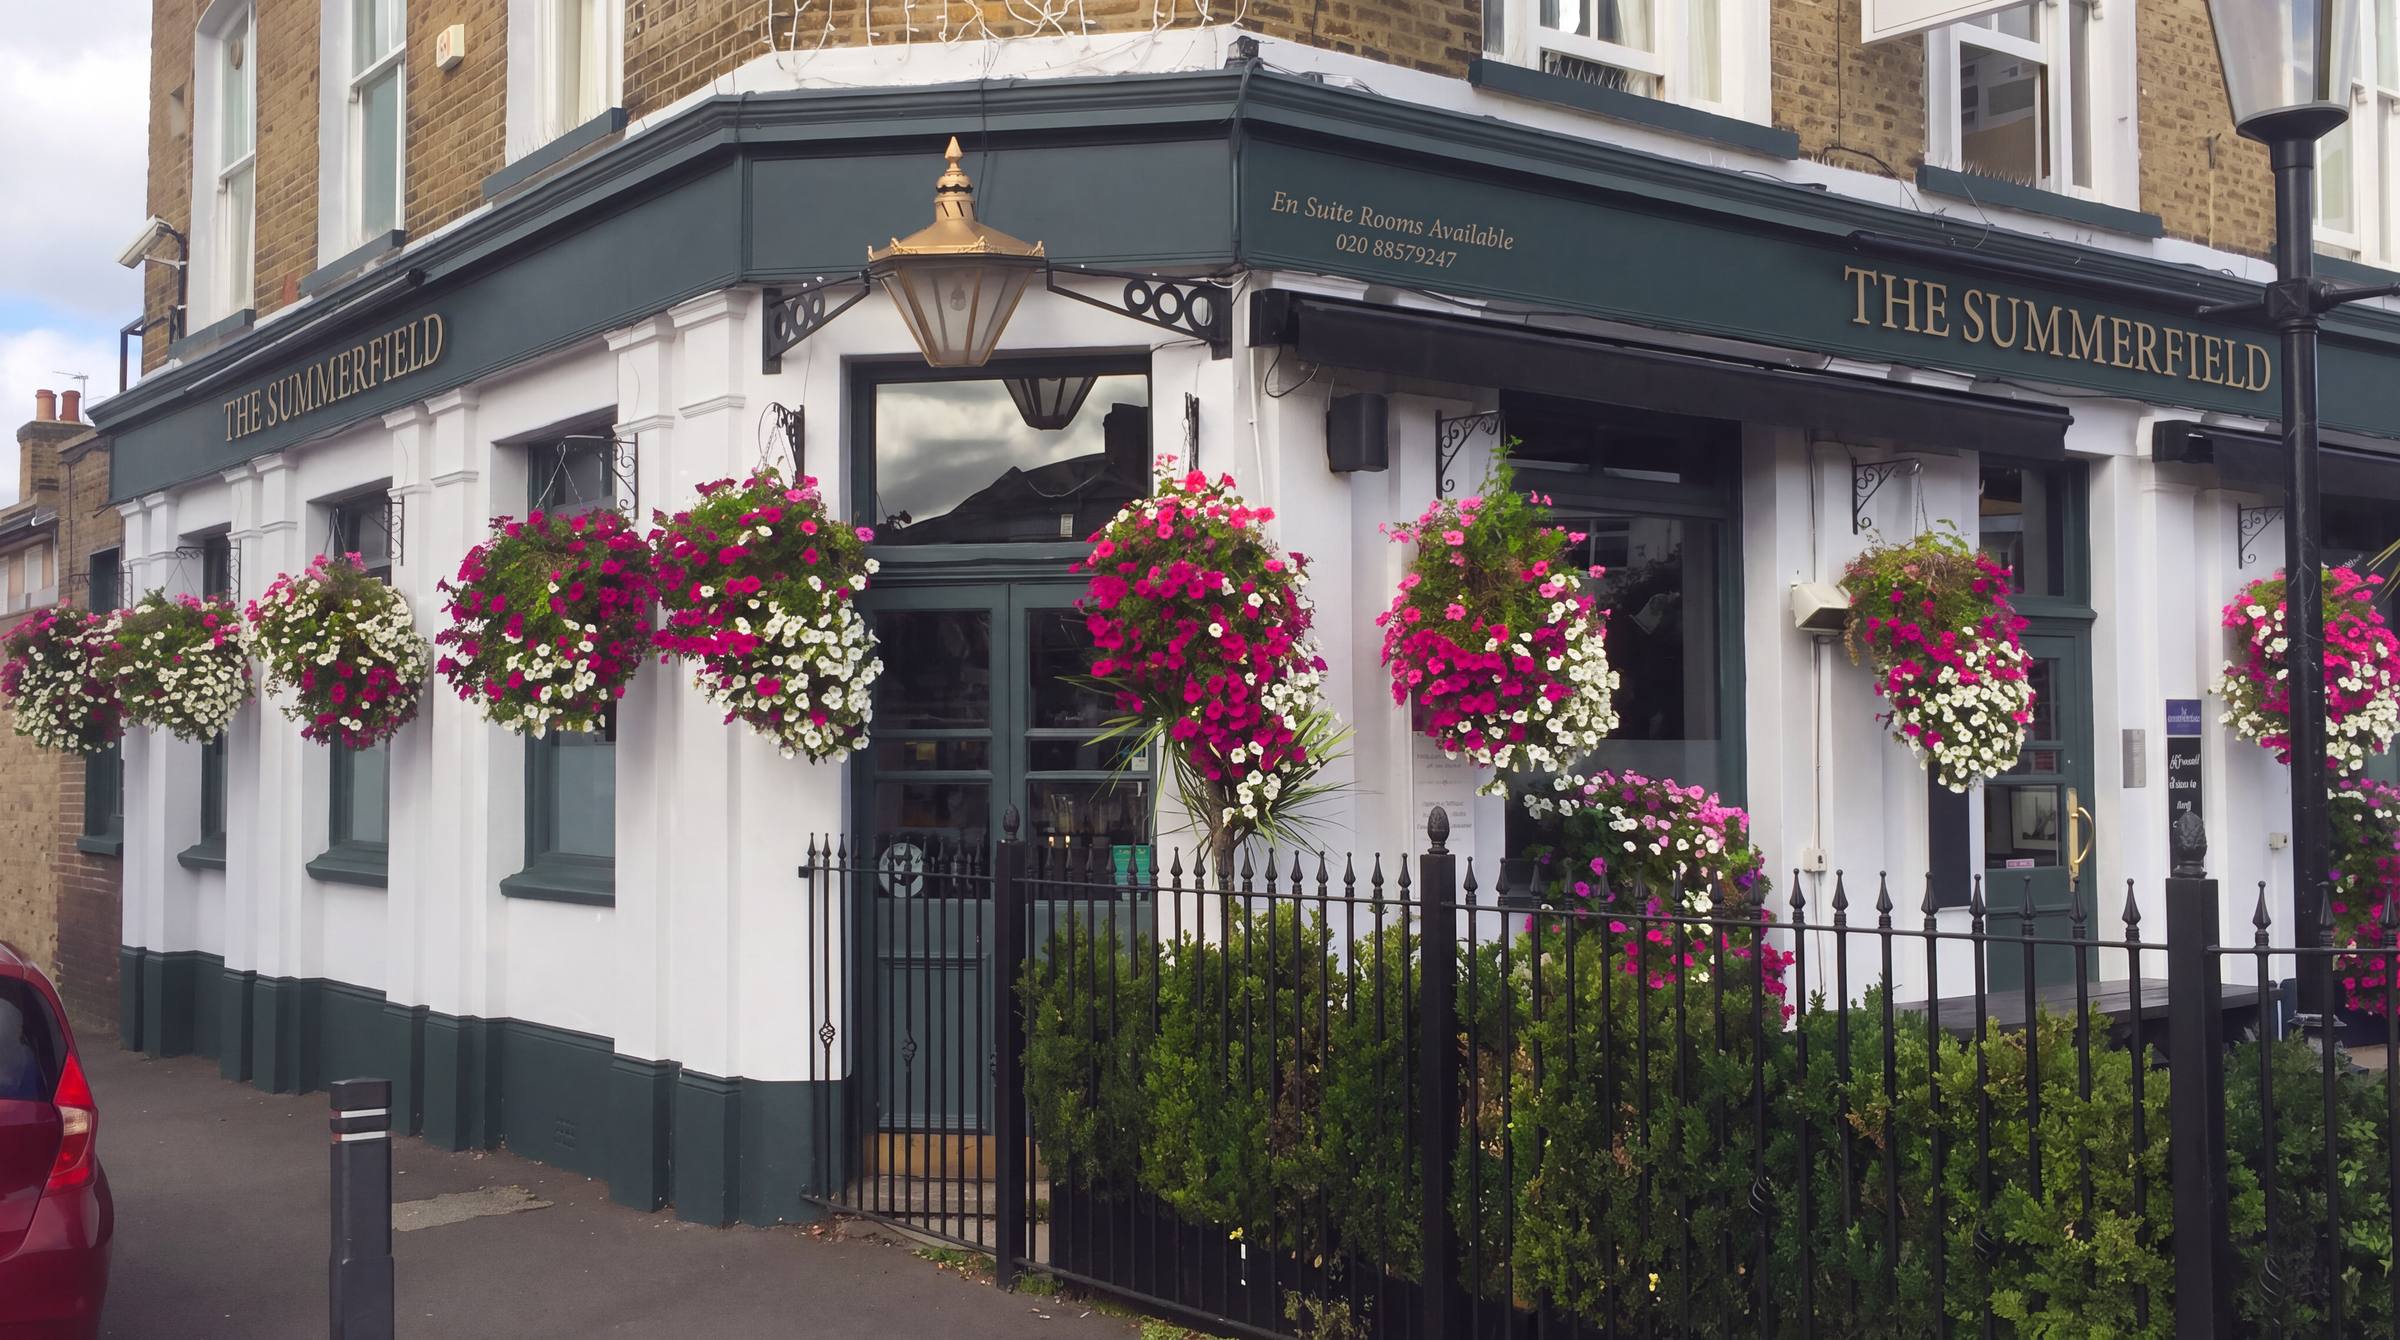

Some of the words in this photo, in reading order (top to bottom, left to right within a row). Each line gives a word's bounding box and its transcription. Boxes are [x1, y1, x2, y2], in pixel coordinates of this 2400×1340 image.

[1270, 190, 1298, 214] En
[1304, 196, 1354, 223] Suite
[1358, 206, 1424, 235] Rooms
[1428, 218, 1514, 250] Available
[1335, 234, 1368, 254] 020
[1372, 239, 1457, 269] 88579247
[1843, 264, 1950, 338] THE
[1962, 288, 2271, 393] SUMMERFIELD
[223, 389, 262, 442] THE
[266, 312, 445, 427] SUMMERFIELD
